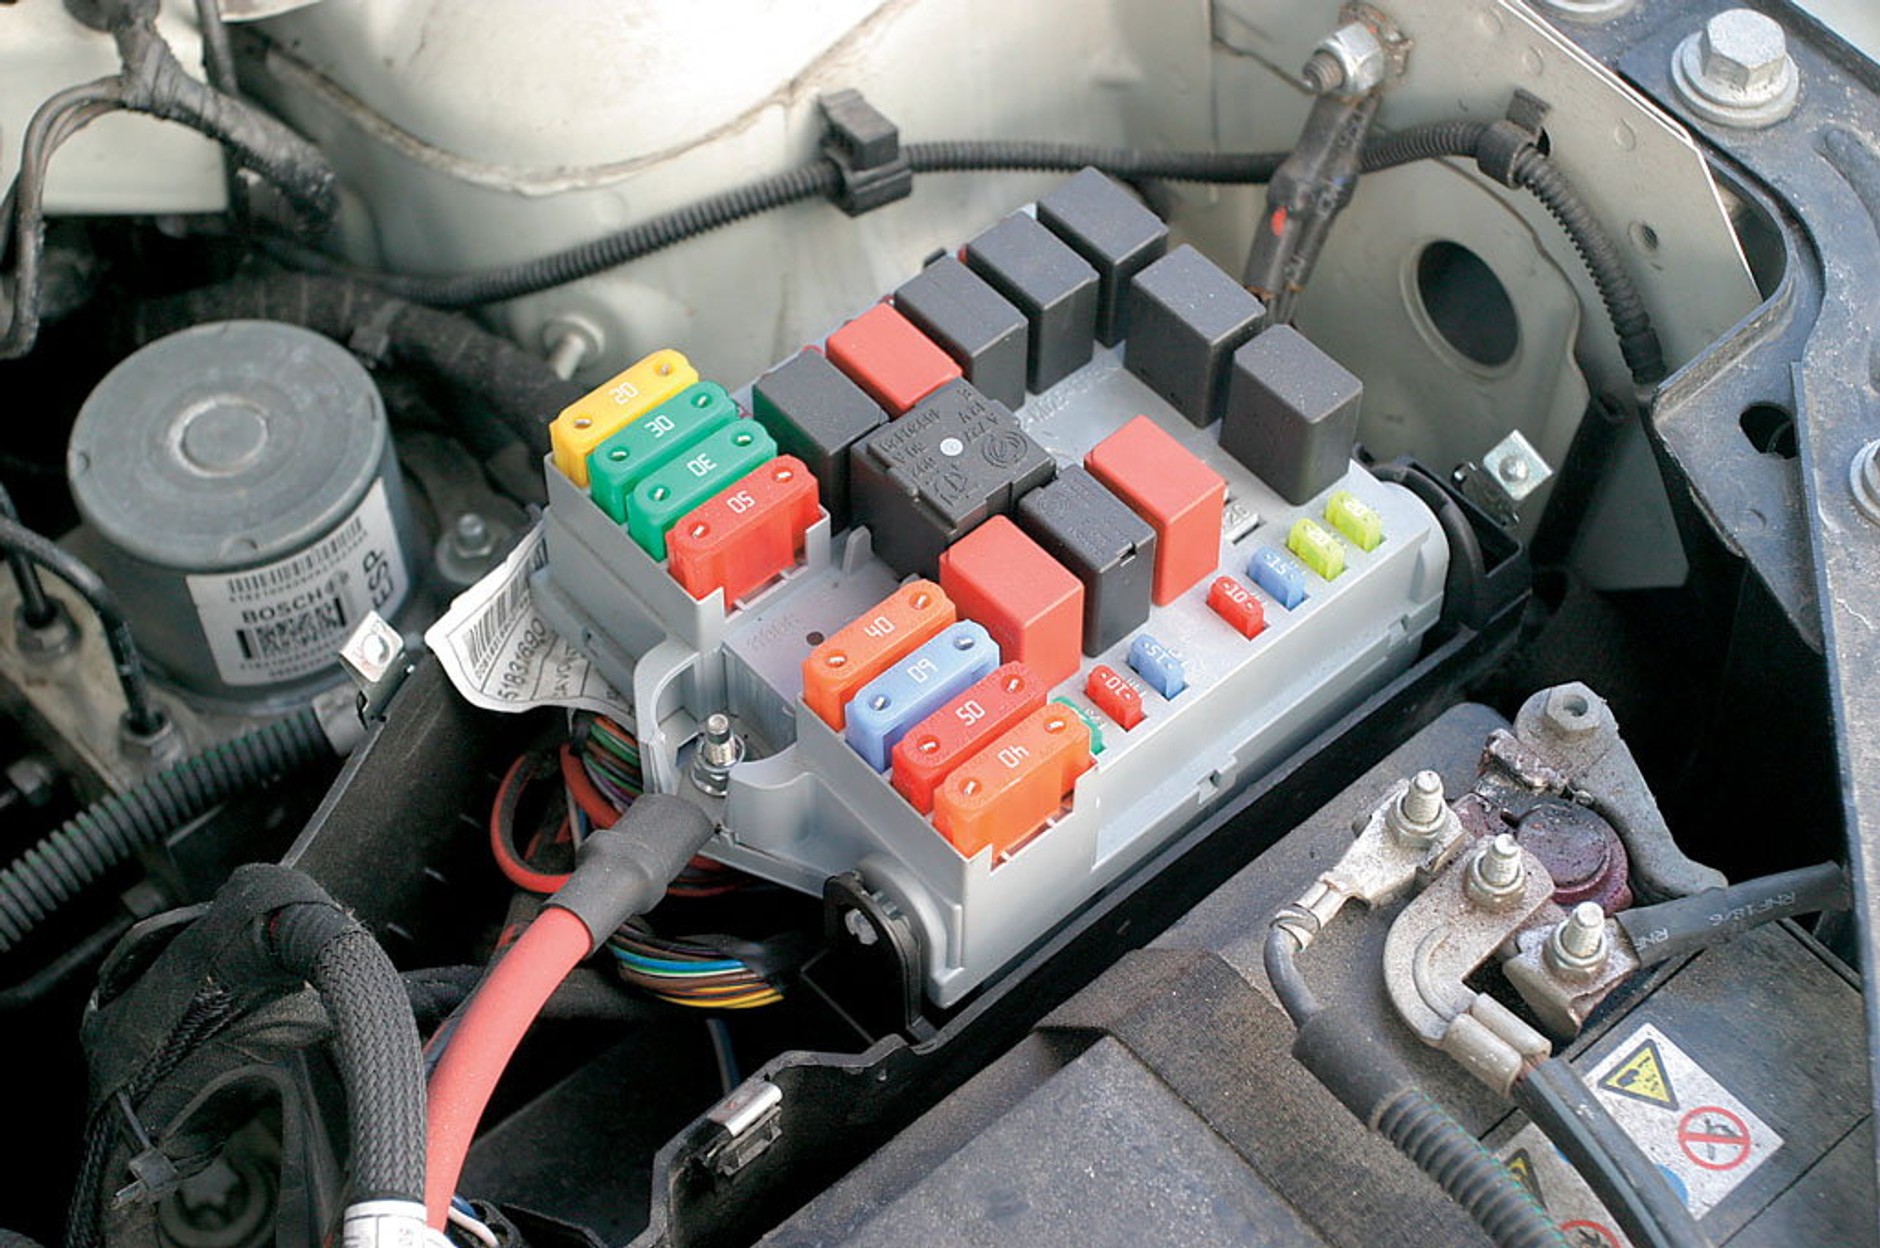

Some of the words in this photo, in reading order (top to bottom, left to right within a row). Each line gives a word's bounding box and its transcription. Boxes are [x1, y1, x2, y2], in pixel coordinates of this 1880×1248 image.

[609, 381, 639, 404] 20
[644, 414, 675, 438] 30
[362, 549, 395, 610] ESP
[241, 586, 323, 624] BOSCH
[1225, 584, 1248, 604] 10
[863, 616, 895, 638] 40
[955, 700, 986, 726] 50
